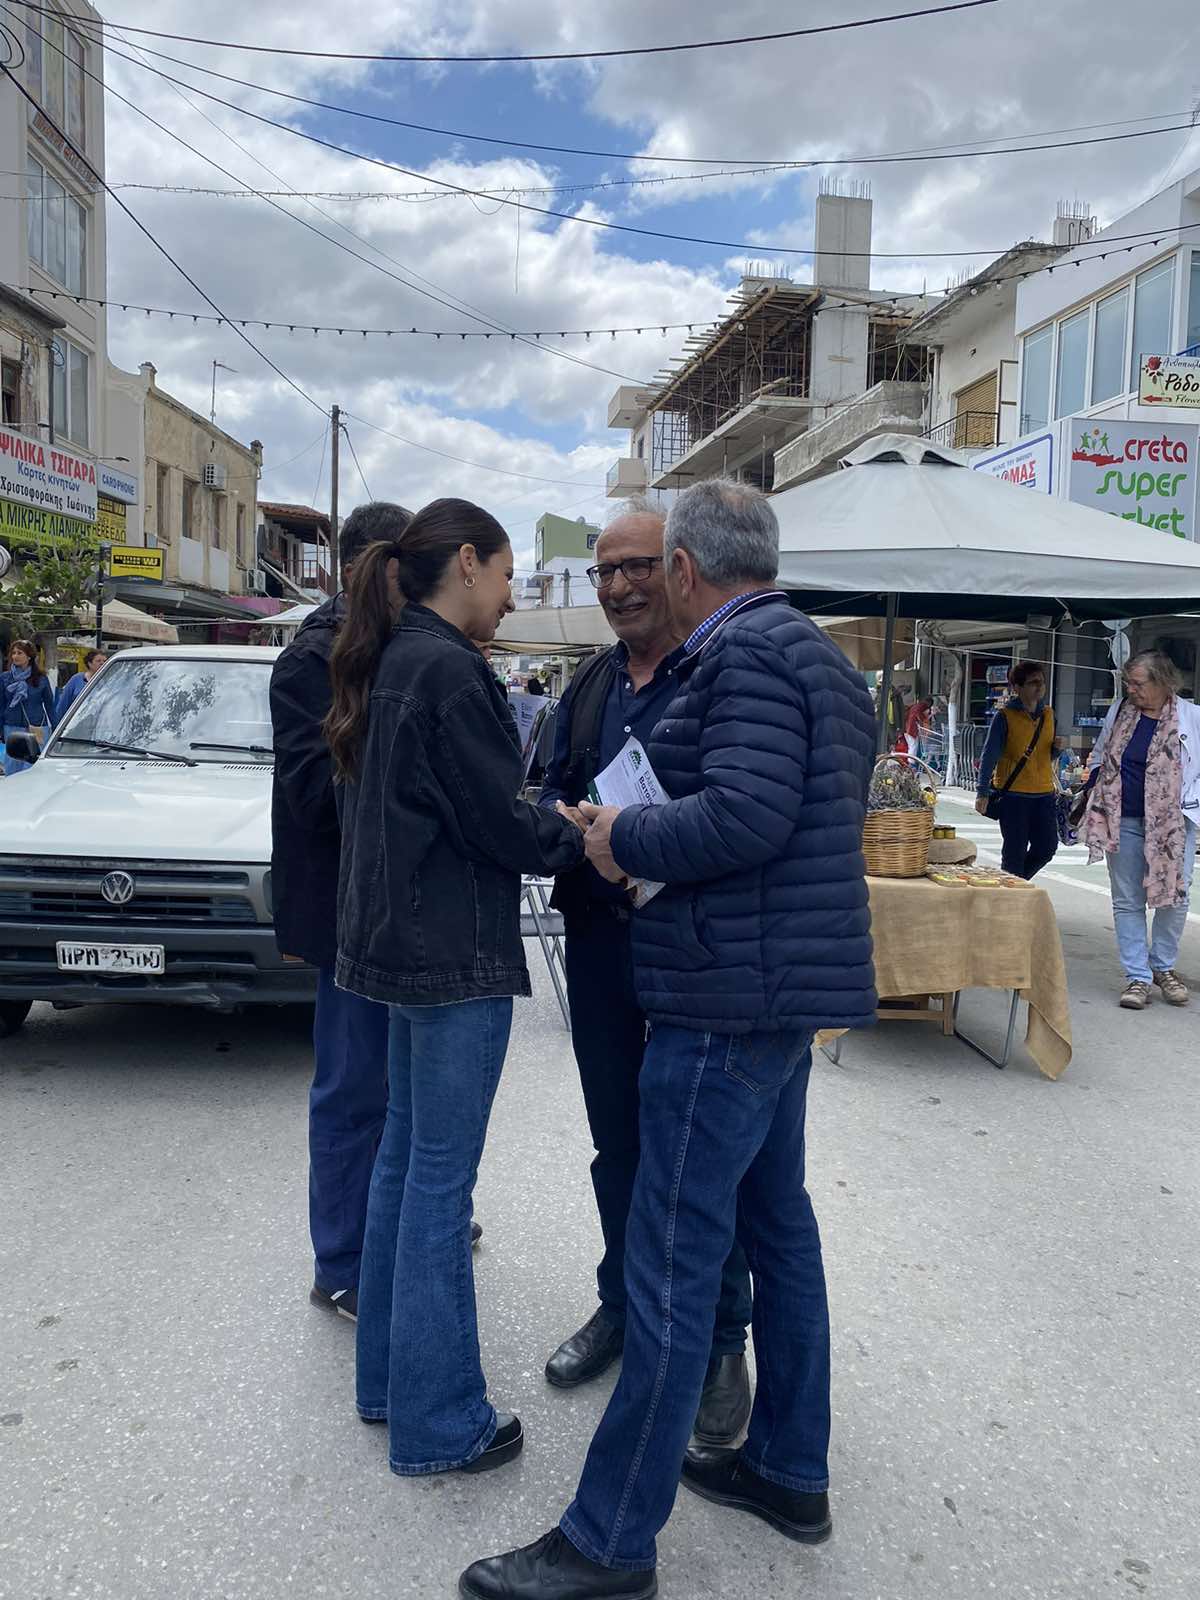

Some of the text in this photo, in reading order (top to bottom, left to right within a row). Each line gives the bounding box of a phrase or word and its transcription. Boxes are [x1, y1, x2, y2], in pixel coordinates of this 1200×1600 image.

[1124, 435, 1187, 463] creta
[17, 461, 80, 492] Κάρτες κινητών
[51, 451, 95, 485] ΤΣΙΓΑΡΑ
[0, 476, 62, 511] Χριστοφοράκης
[67, 496, 95, 520] Ιωάννης
[1096, 471, 1187, 501] super
[7, 503, 46, 533] ΜΙΚΡΗΣ
